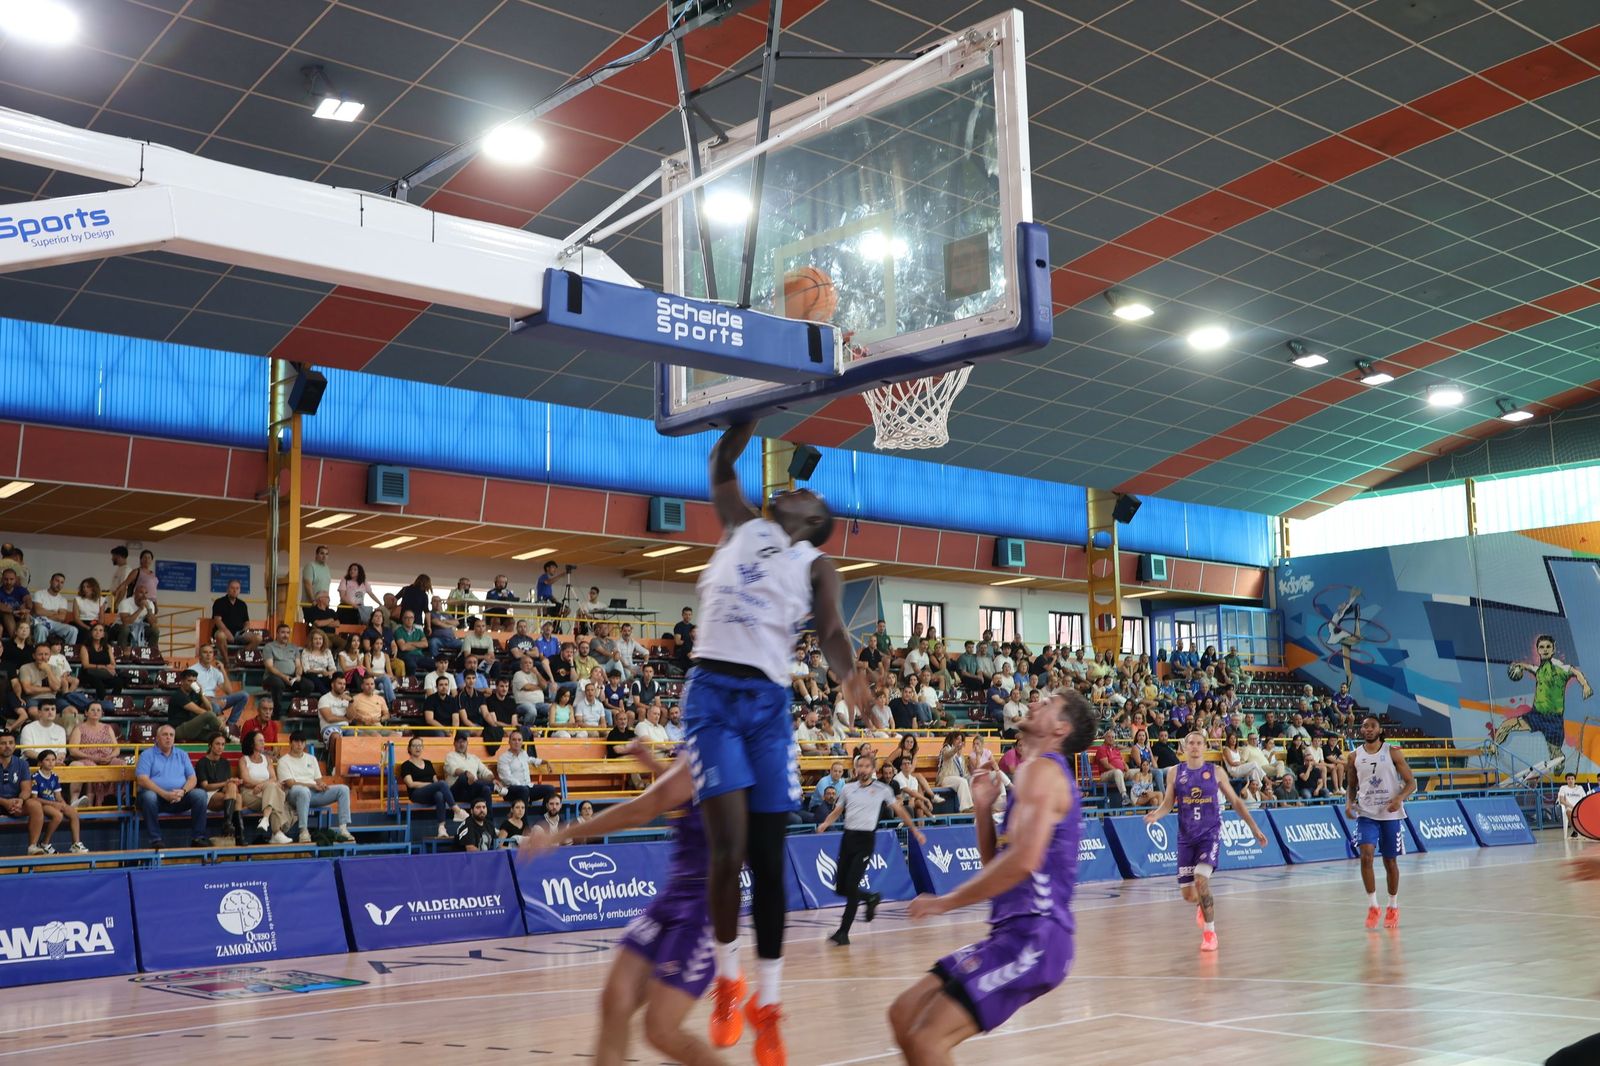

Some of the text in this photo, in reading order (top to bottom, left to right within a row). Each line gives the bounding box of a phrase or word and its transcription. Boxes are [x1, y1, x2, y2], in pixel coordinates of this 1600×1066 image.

[0, 208, 110, 243] Sports
[31, 229, 115, 248] Superior by Design
[656, 296, 743, 330] Schelde
[656, 315, 744, 347] Sports
[1370, 762, 1377, 774] 7
[1193, 806, 1201, 821] 5
[1284, 822, 1341, 843] ALIMERKA
[960, 862, 973, 871] DE
[407, 895, 501, 912] VALDERADUEY
[541, 877, 657, 913] Melquiades
[561, 912, 598, 922] Jamones
[600, 912, 605, 922] y
[216, 941, 272, 957] ZAMORANO
